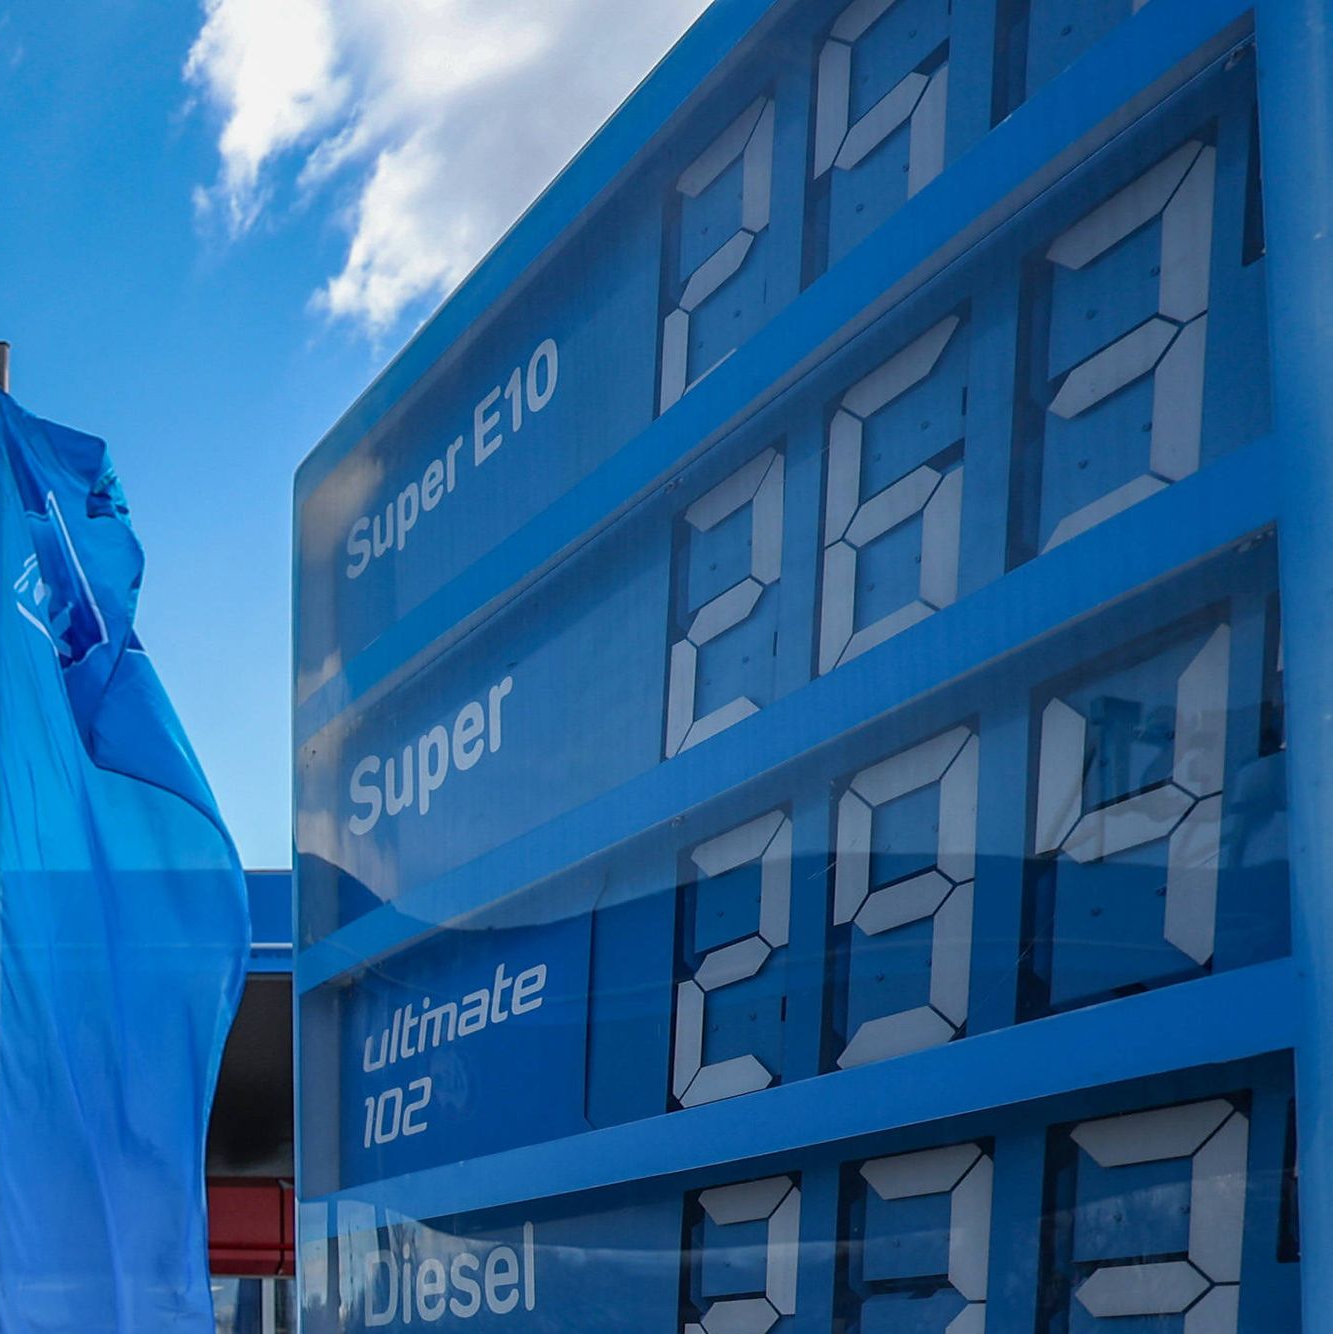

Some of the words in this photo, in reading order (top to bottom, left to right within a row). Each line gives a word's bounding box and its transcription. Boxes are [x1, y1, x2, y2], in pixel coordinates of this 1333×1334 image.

[346, 434, 464, 580] Super
[474, 338, 559, 467] E10
[348, 675, 514, 836] Super
[362, 962, 547, 1074] ultimate
[363, 1075, 432, 1149] 102
[365, 1221, 536, 1327] Diesel
